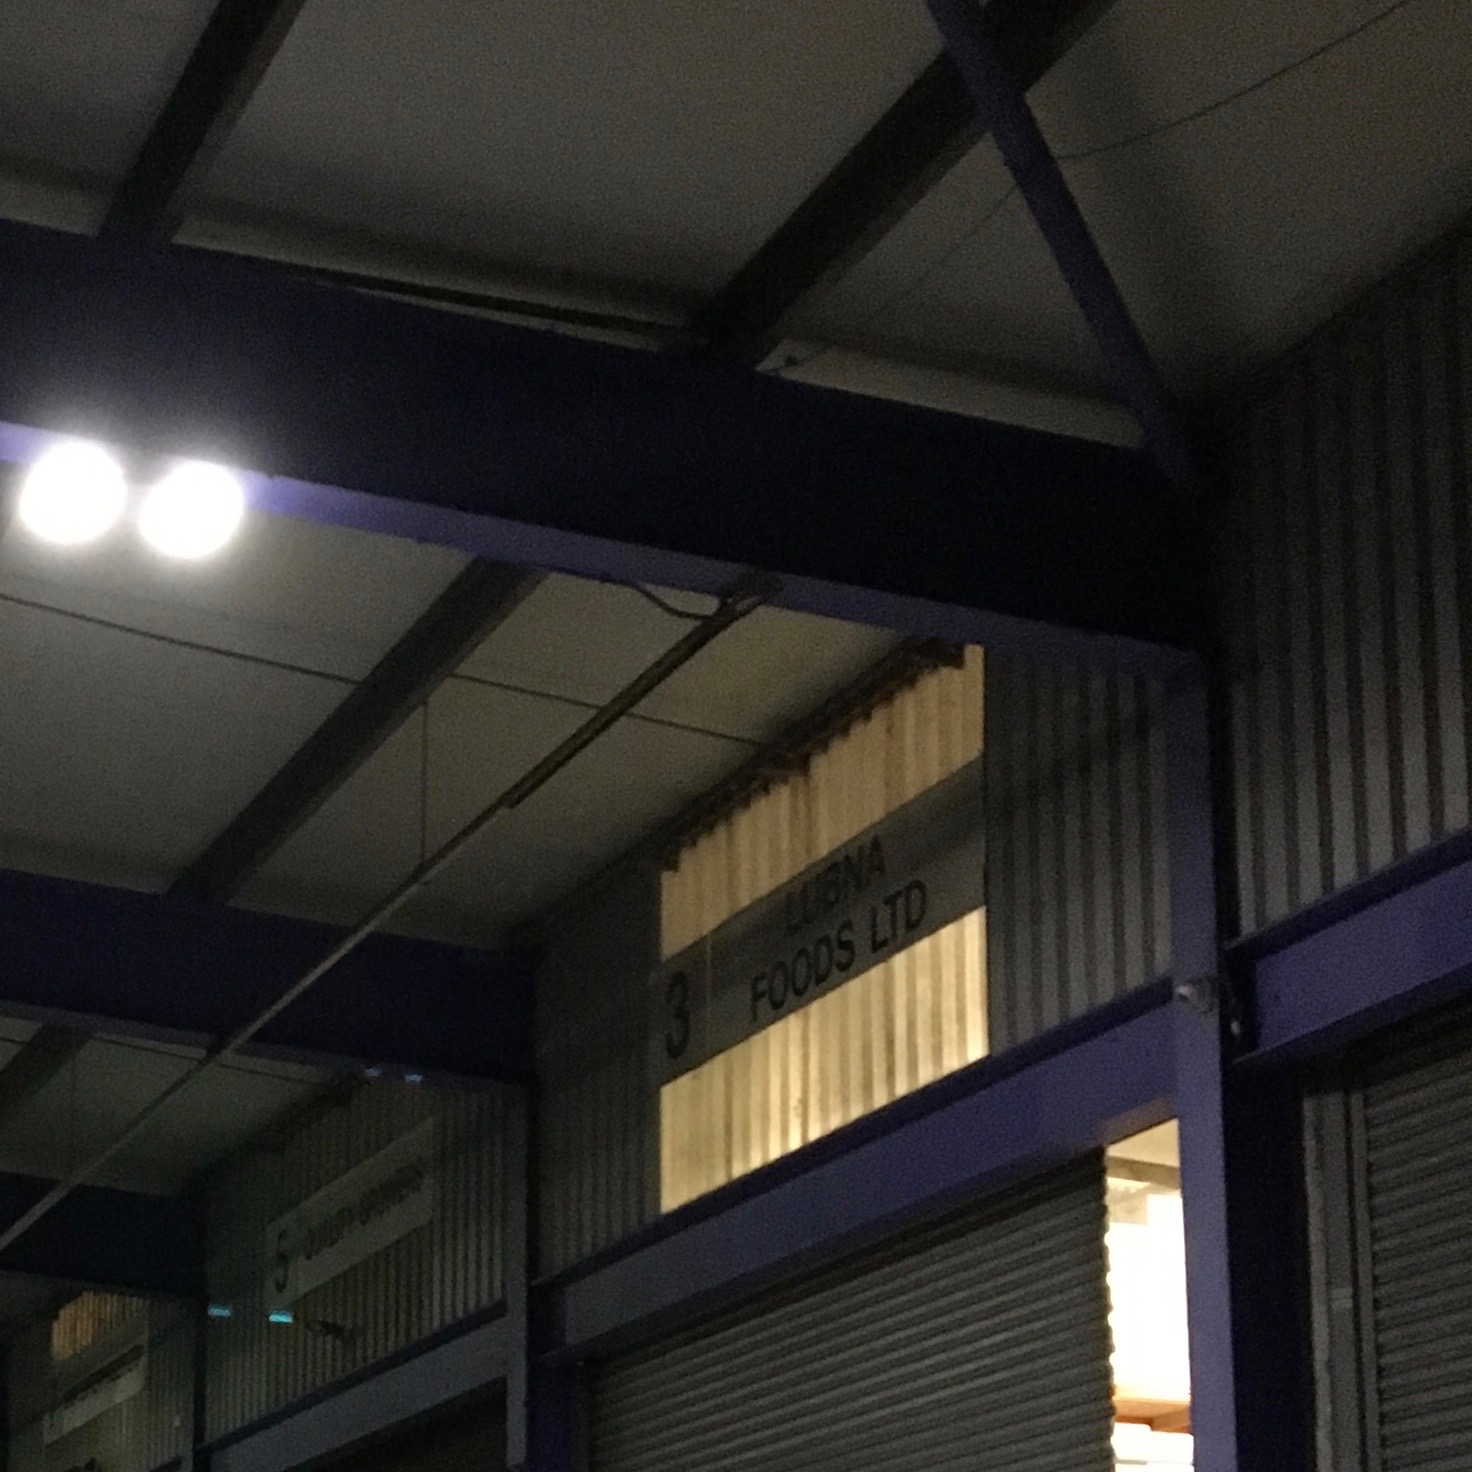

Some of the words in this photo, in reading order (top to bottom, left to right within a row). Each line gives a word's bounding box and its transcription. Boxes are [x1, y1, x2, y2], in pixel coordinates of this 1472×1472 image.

[750, 919, 856, 1024] FOODS
[870, 879, 928, 955] LTD
[664, 970, 691, 1060] 3
